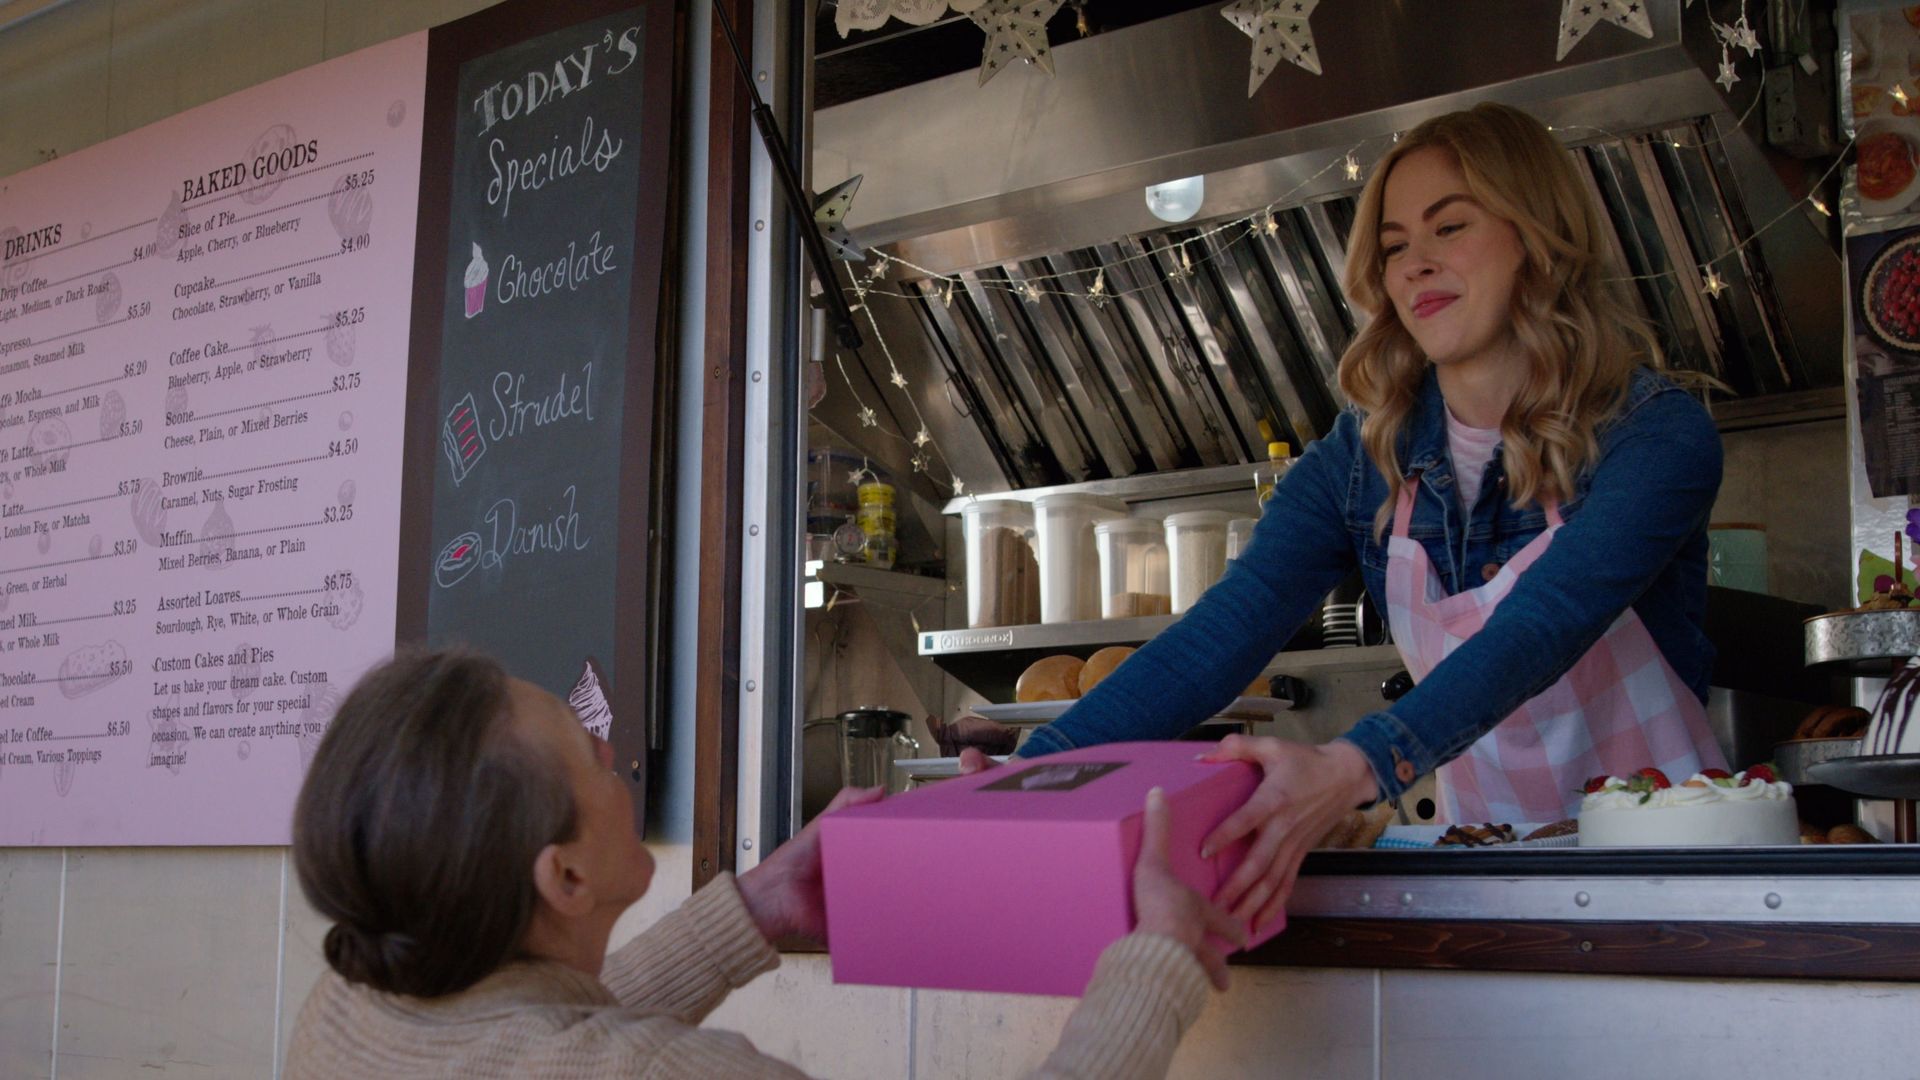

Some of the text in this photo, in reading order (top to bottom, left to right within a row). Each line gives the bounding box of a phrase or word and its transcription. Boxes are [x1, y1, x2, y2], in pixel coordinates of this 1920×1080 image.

[473, 25, 641, 137] TODAY'S
[181, 140, 318, 203] BAKED GOODS
[487, 116, 623, 218] Specials
[178, 169, 375, 240] Slice of Pie $5.25
[4, 223, 62, 261] DRINKS
[176, 217, 301, 262] Apple, Cherry, or Blueberry
[0, 242, 158, 302] Drip Coffee $4.00
[174, 233, 370, 299] Cupcake $4.00
[497, 230, 617, 304] Chocolate
[54, 295, 63, 306] or
[65, 287, 84, 303] Dark
[87, 281, 110, 297] Roast
[127, 301, 151, 320] $5.50
[172, 272, 322, 321] Chocolate, Strawberry, or Vanilla
[169, 307, 365, 366] Coffee Cake $5.25
[33, 347, 65, 366] Steamed
[67, 342, 86, 358] Milk
[168, 347, 312, 390] Blueberry, Apple, or Strawberry
[15, 387, 42, 405] Mocha
[123, 359, 147, 379] $6.20
[331, 371, 361, 393] $3.75
[28, 406, 62, 423] Espresso,
[65, 399, 80, 414] and
[81, 394, 100, 410] Milk
[489, 361, 594, 441] Strudel
[11, 445, 34, 461] Latte
[119, 419, 143, 437] $5.50
[164, 410, 309, 449] Cheese, Plain, or Mixed Berries
[13, 471, 21, 481] or
[24, 463, 47, 478] Whole
[49, 459, 67, 473] Milk
[162, 437, 359, 487] Brownie $4.50
[2, 478, 140, 518] Latte $5.75
[160, 476, 299, 511] Caramel, Nuts, Sugar Frosting
[4, 523, 31, 539] London
[51, 520, 60, 530] or
[62, 512, 90, 528] Matcha
[159, 503, 353, 548] Muffin $3.25
[481, 485, 591, 571] Danish
[113, 538, 137, 557] $3.50
[158, 537, 306, 571] Mixed Berries, Banana, or Plain
[32, 580, 40, 591] or
[42, 573, 67, 589] Herbal
[156, 572, 353, 612] Assorted Loaves $6.75
[18, 612, 37, 628] Milk
[113, 599, 136, 616] $3.25
[155, 602, 340, 635] Sourdough, Rye, White, or Whole Grain
[7, 640, 15, 651] or
[18, 636, 41, 649] Whole
[42, 633, 60, 647] Milk
[109, 660, 133, 677] $5.50
[154, 647, 275, 672] Custom Cakes and Pies
[153, 682, 169, 696] Let
[171, 684, 181, 695] us
[184, 679, 204, 694] bake
[206, 679, 227, 695] your
[230, 676, 260, 690] dream
[290, 669, 328, 685] Custom
[11, 694, 35, 707] Cream
[152, 694, 311, 721] shapes and flavors for your special
[11, 728, 24, 743] Ice
[26, 726, 53, 742] Coffee
[107, 720, 130, 737] $6.50
[193, 726, 207, 739] We
[209, 728, 225, 739] can
[227, 724, 257, 738] create
[259, 720, 301, 739] anything
[303, 722, 321, 738] you
[36, 750, 64, 763] Various
[67, 747, 102, 764] Toppings
[150, 751, 188, 769] imagine!
